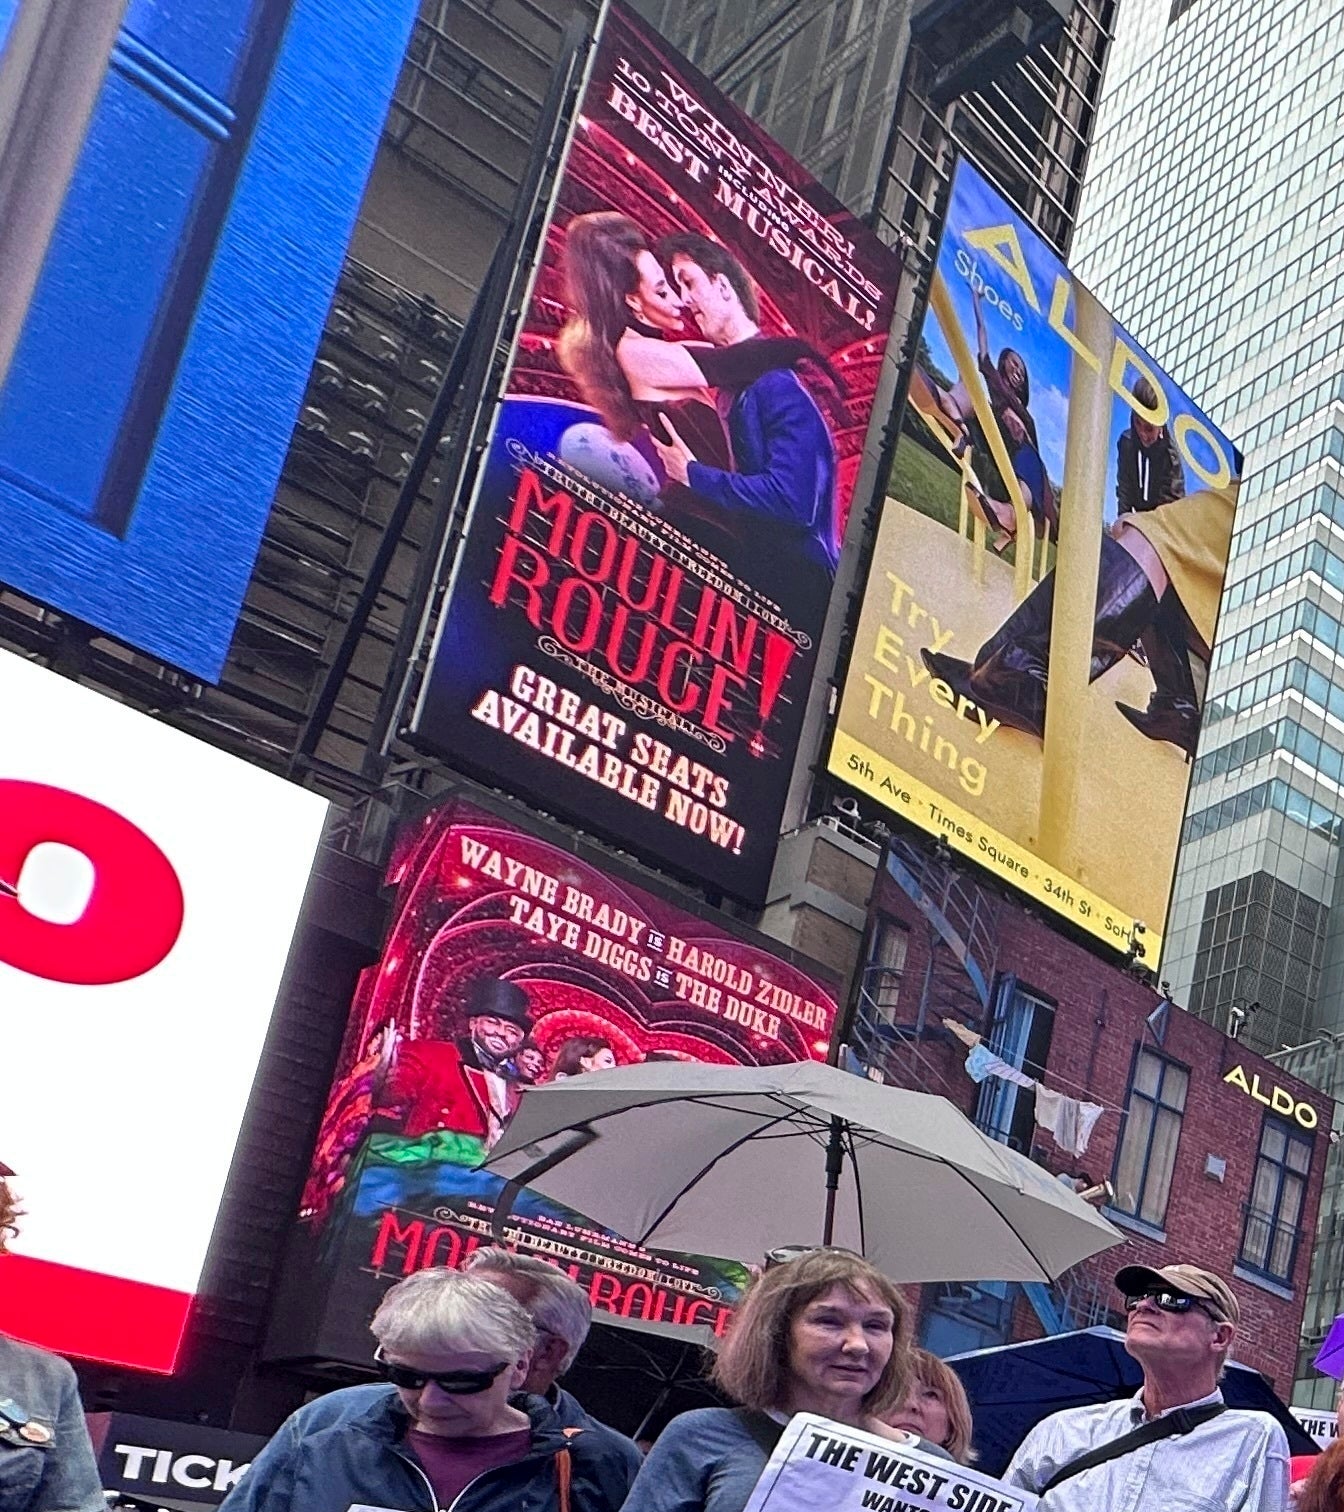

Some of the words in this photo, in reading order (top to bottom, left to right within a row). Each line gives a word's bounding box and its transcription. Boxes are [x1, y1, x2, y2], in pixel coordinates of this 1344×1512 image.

[607, 82, 709, 184] BEST
[713, 178, 876, 333] MUSICAL!
[616, 57, 651, 94] 10
[655, 88, 752, 181] TONY
[753, 184, 885, 301] AWARDS
[718, 164, 790, 232] INCLUDING
[954, 249, 1024, 332] Shoes
[962, 223, 1232, 490] ALDO
[509, 465, 760, 673] MOULIN
[885, 571, 955, 655] Try
[511, 664, 628, 751] GREAT
[631, 732, 731, 810] SEATS
[863, 672, 988, 798] Thing
[873, 624, 1002, 744] Every
[471, 689, 662, 812] AVAILABLE
[664, 789, 747, 856] NOW!
[847, 754, 875, 782] 5th
[880, 775, 913, 806] Ave
[928, 803, 974, 845] Times
[978, 835, 1031, 881] Square
[1042, 877, 1076, 908] 34th
[1078, 898, 1093, 919] St
[460, 835, 559, 906] WAYNE
[561, 885, 647, 948] BRADY
[666, 935, 752, 997] HAROLD
[757, 977, 829, 1033] ZIDLER
[508, 895, 578, 951] TAYE
[583, 930, 651, 984] DIGGS
[675, 972, 724, 1019] THE
[723, 993, 781, 1041] DUKE
[1222, 1063, 1320, 1130] ALDO
[114, 1444, 251, 1492] TICK
[805, 1433, 864, 1473] THE
[864, 1452, 950, 1501] WEST
